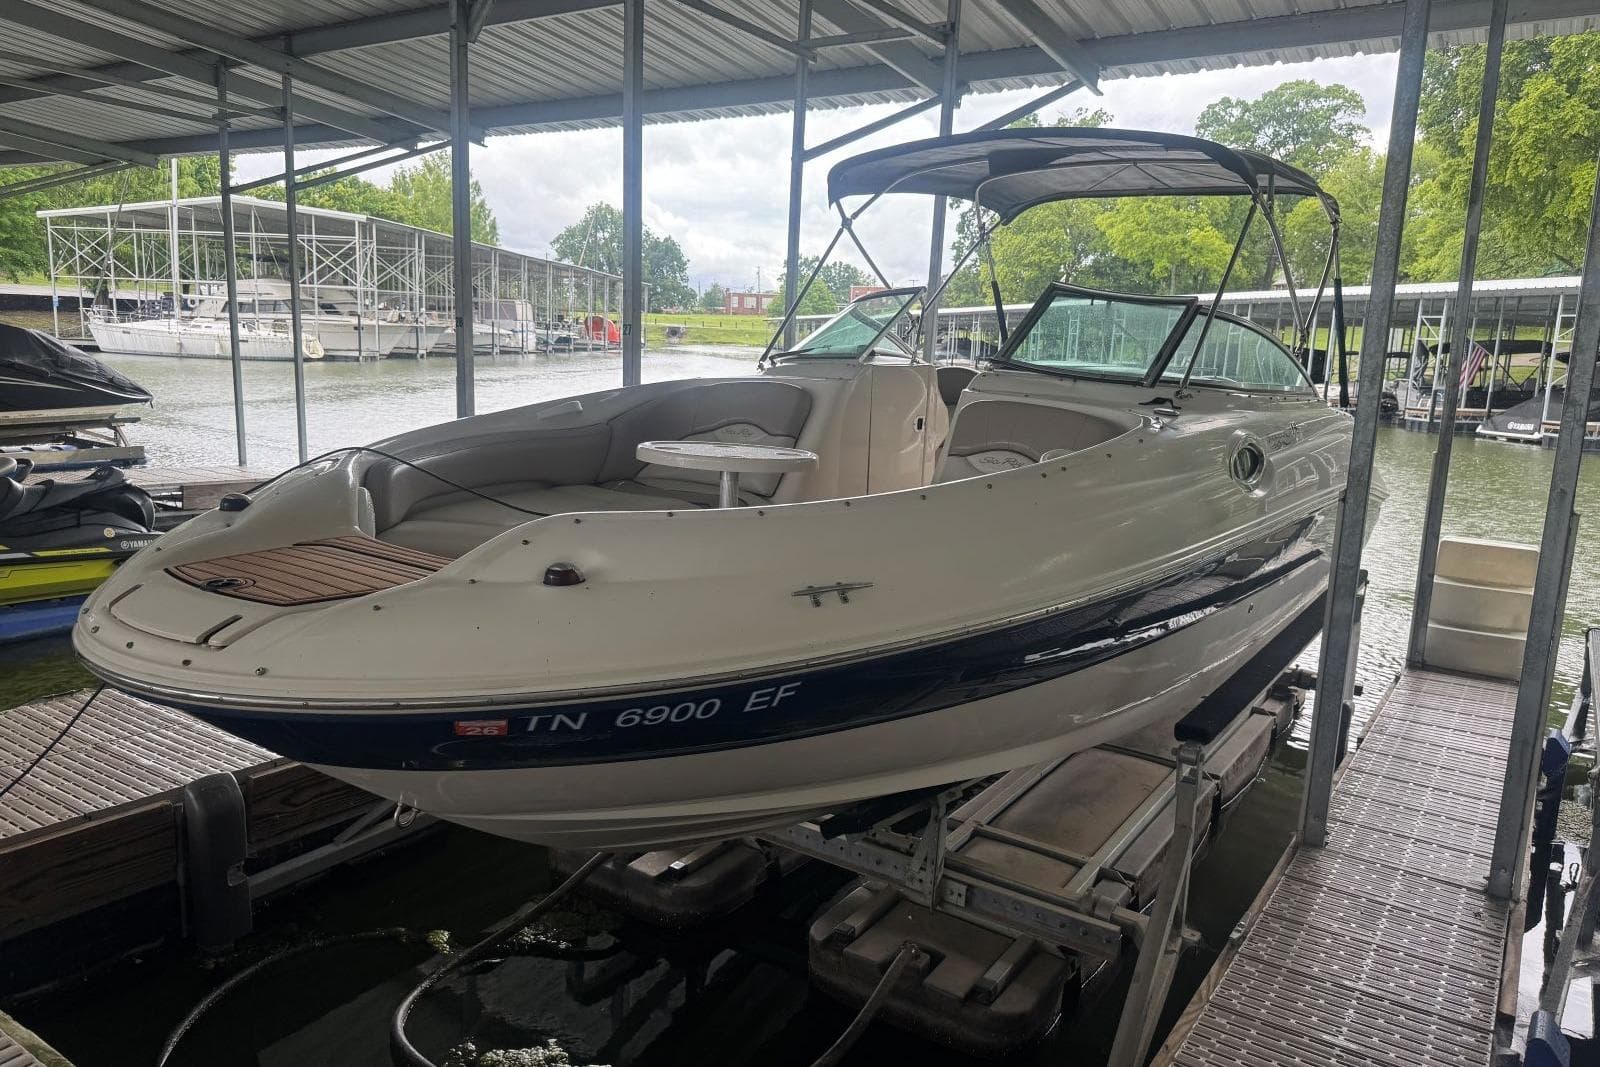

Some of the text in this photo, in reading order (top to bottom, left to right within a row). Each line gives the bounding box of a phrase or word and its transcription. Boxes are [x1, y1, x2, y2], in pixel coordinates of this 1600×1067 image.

[623, 323, 632, 335] 27
[519, 681, 802, 732] TN 6900 EF
[465, 726, 499, 736] 26
